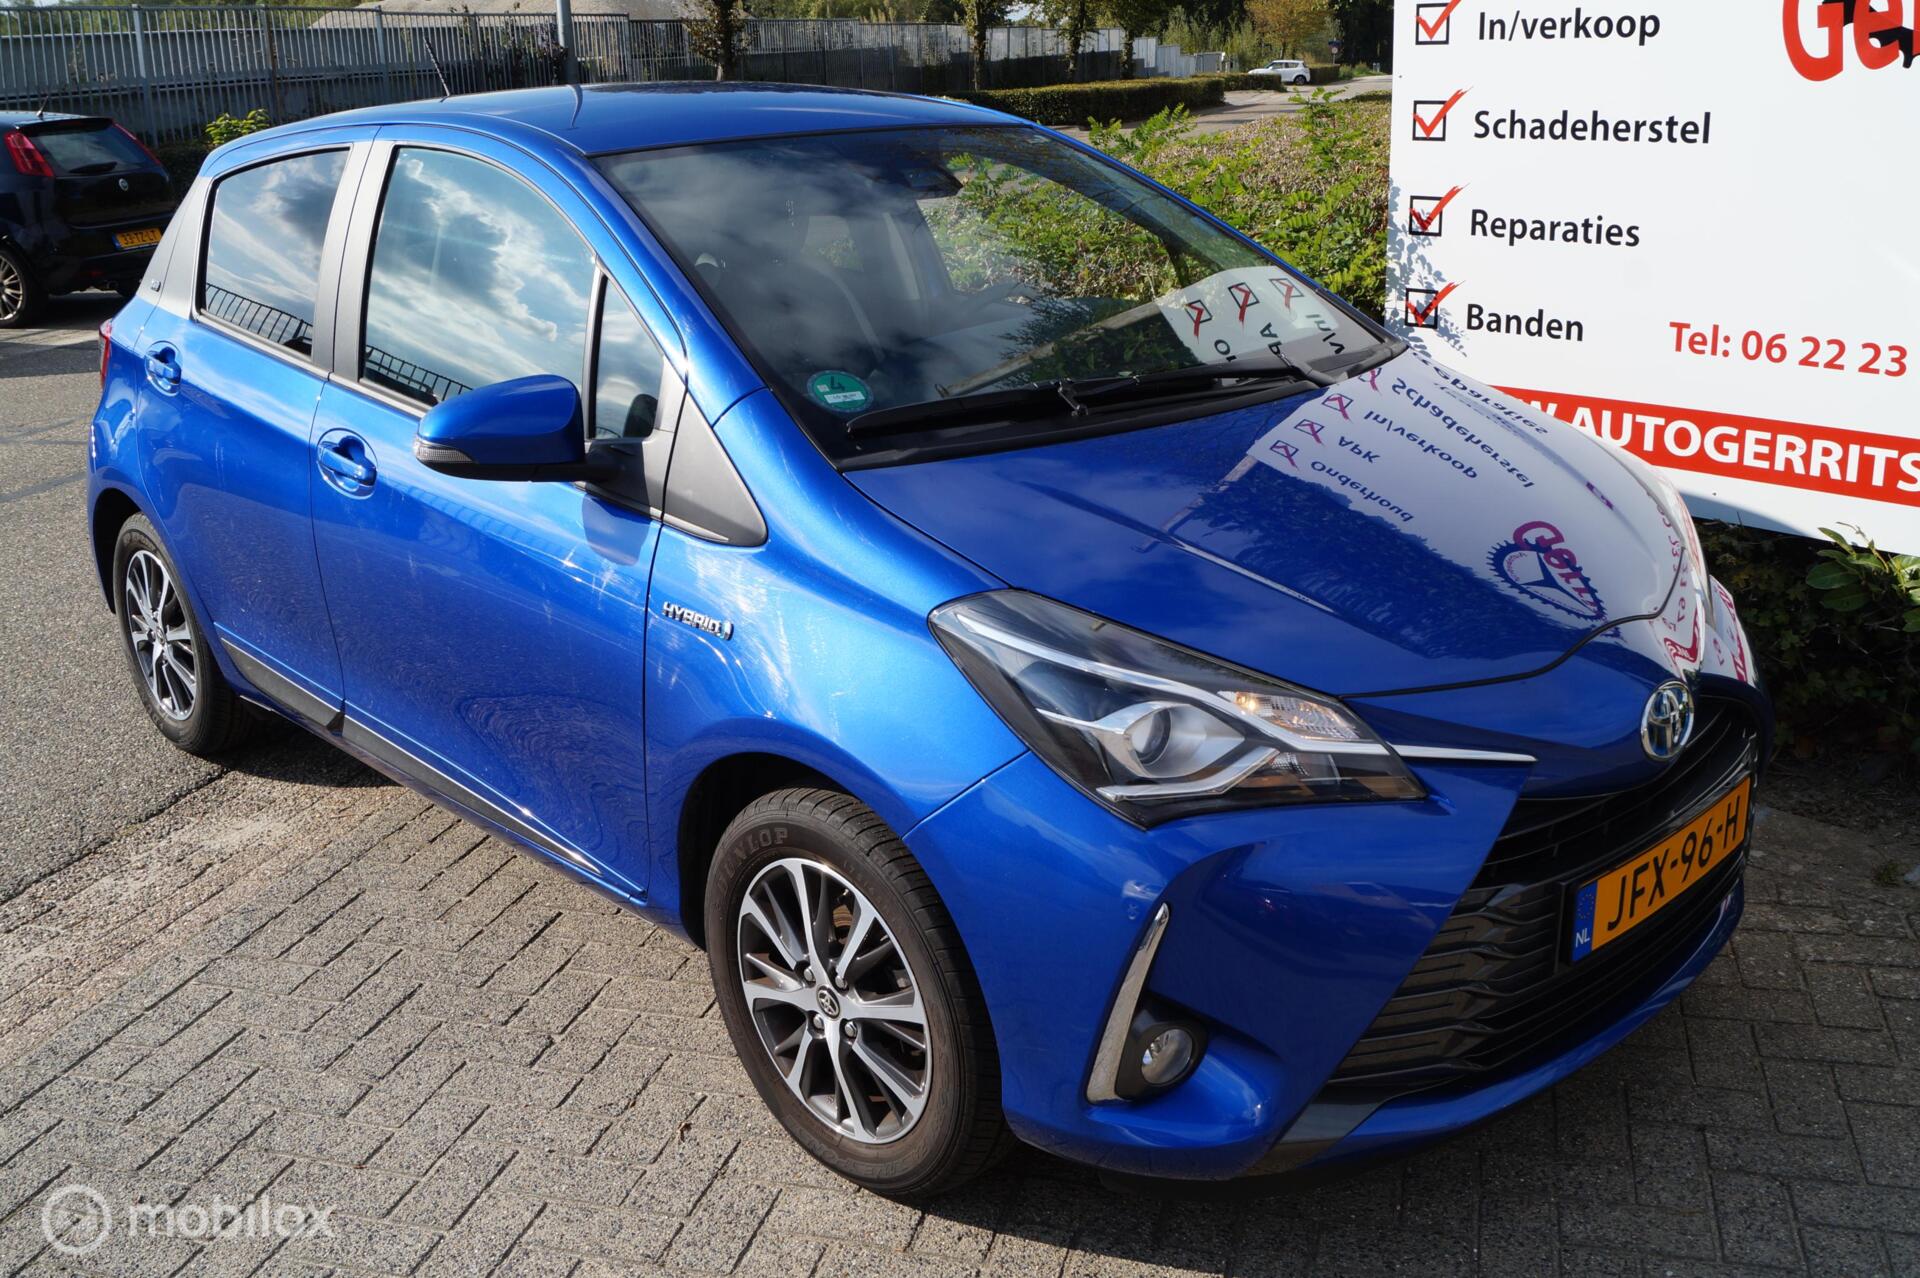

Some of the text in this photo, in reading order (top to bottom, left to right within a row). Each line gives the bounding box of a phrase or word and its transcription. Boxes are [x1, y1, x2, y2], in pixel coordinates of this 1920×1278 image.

[1478, 7, 1661, 46] In/verkoop
[1782, 0, 1920, 81] Ge
[1473, 110, 1712, 145] Schadeherstel
[1470, 209, 1641, 248] Reparaties
[1465, 303, 1584, 342] Banden
[1669, 322, 1908, 377] Tel: 06 22 23
[662, 601, 722, 636] HYBRID
[1607, 795, 1740, 931] JFX-96-H
[1575, 927, 1591, 948] NL
